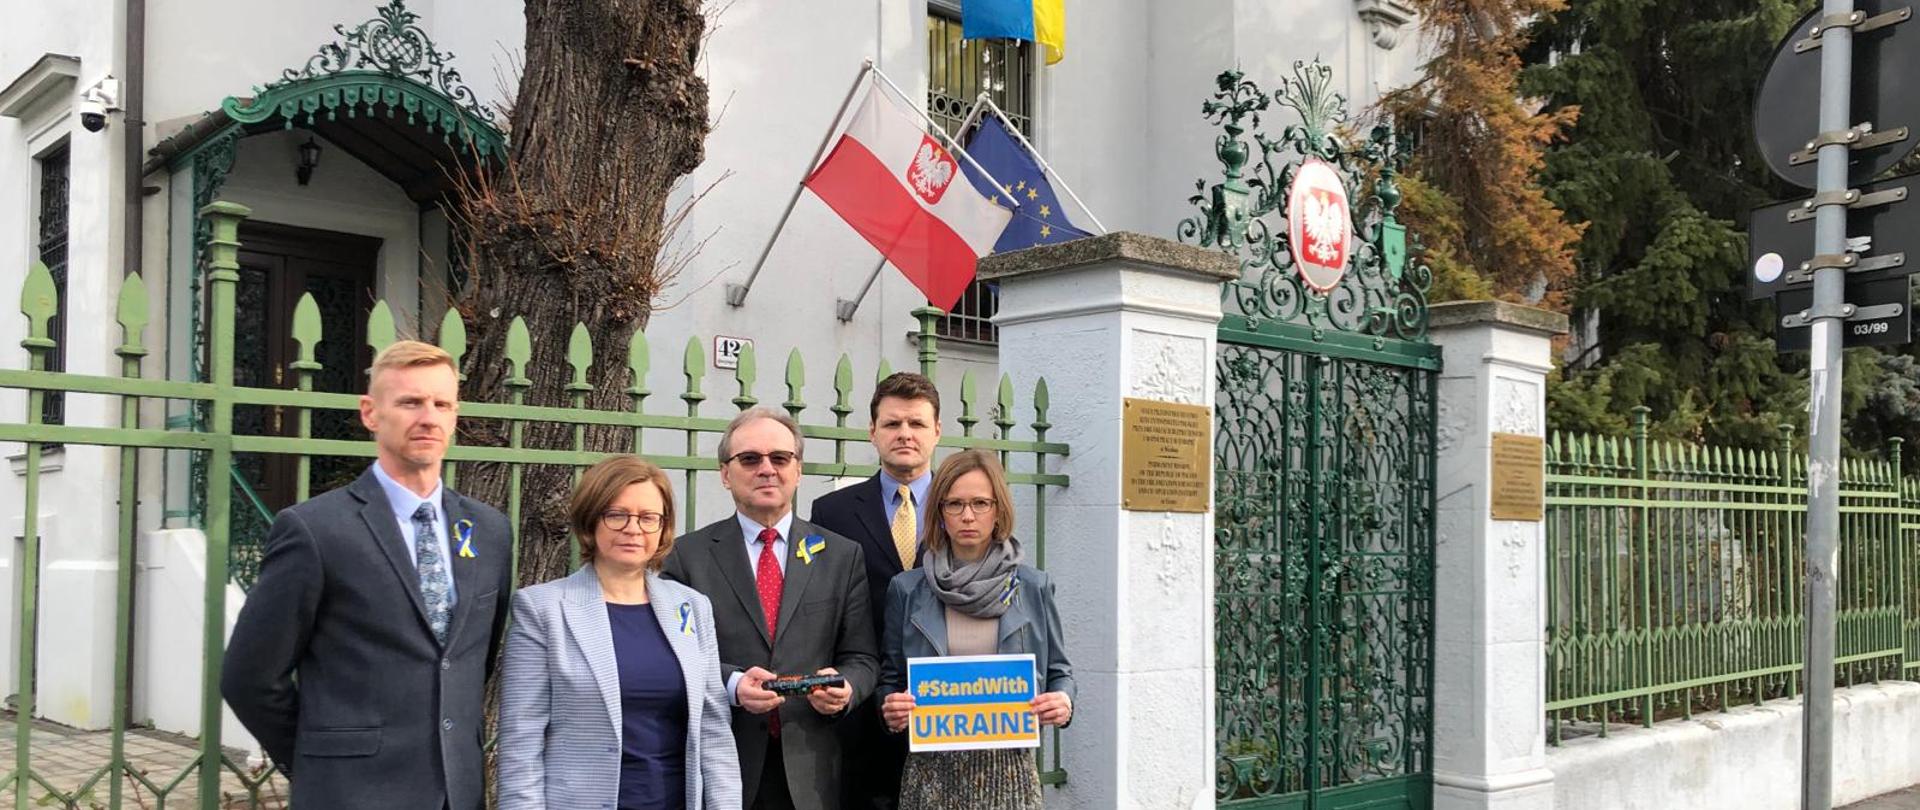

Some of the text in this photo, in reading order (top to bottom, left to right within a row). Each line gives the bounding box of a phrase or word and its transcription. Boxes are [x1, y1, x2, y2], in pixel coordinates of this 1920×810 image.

[1854, 322, 1888, 335] 03/99
[917, 676, 1029, 697] #StandWith
[915, 711, 1036, 738] UKRAINE
